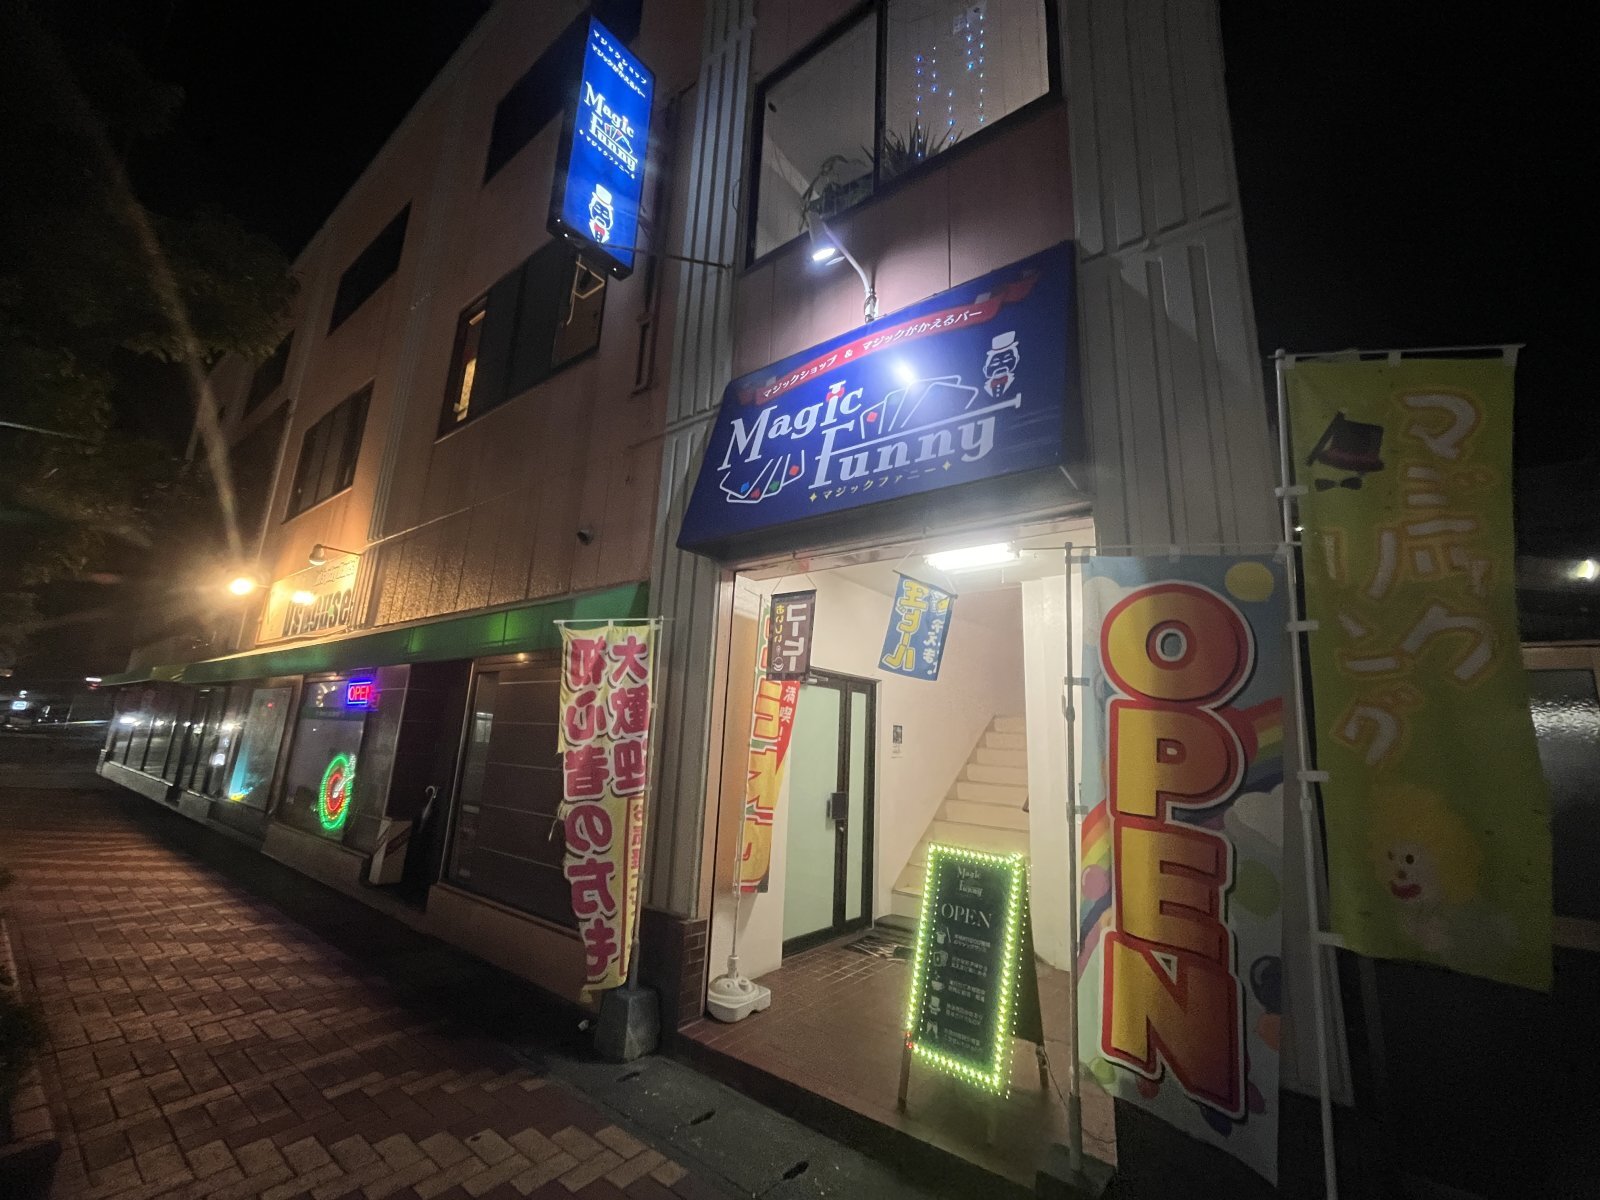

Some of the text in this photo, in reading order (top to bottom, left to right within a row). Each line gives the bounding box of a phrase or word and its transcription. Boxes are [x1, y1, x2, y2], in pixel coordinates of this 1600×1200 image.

[584, 81, 634, 138] Magic
[589, 112, 638, 171] Funny
[764, 309, 983, 398] マジックショップ & マジックがかえるバー
[717, 380, 864, 471] Magic
[808, 394, 1021, 490] Funny
[823, 468, 937, 500] マジックファニー
[1100, 580, 1255, 1119] OPEN
[941, 903, 992, 928] OPEN
